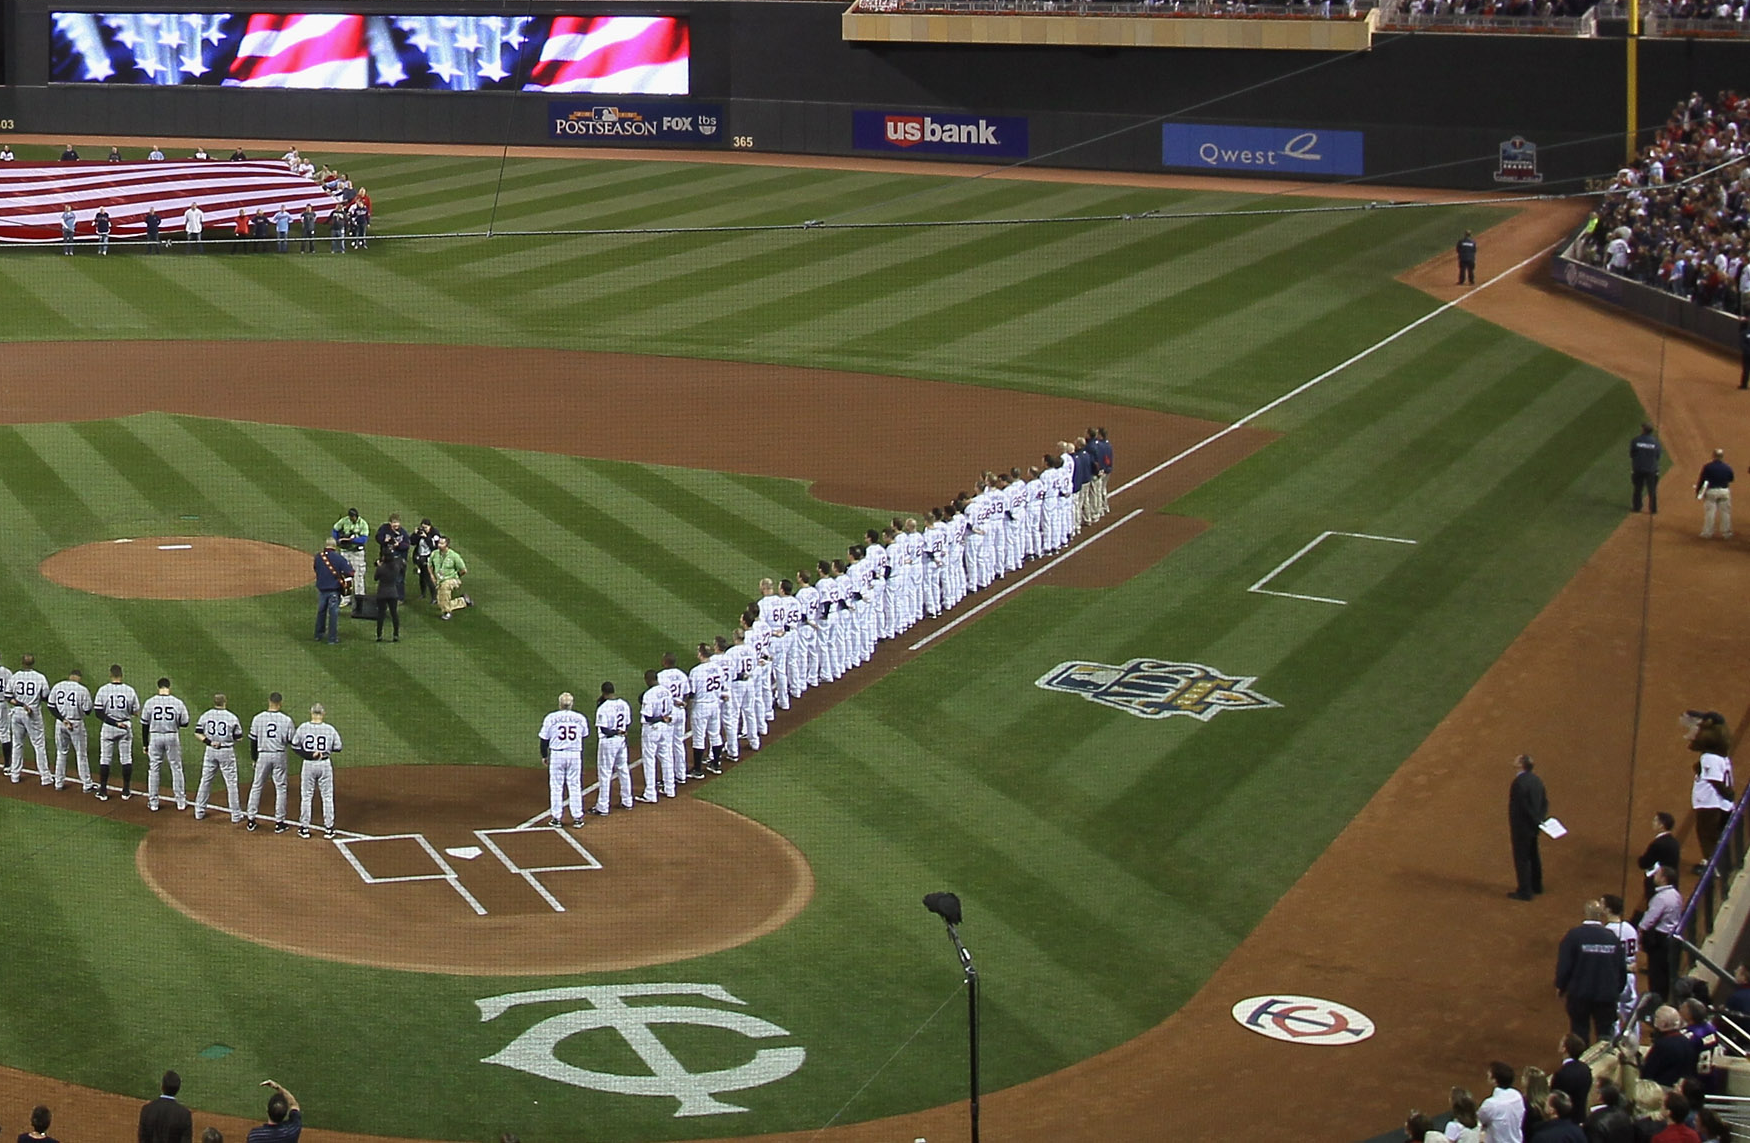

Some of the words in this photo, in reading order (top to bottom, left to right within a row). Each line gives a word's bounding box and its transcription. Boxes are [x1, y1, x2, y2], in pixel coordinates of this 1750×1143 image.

[556, 119, 657, 136] POSTSEASON
[663, 116, 693, 131] FOX
[698, 115, 717, 126] tbs
[733, 136, 754, 148] 365
[1200, 143, 1277, 165] Qwest
[773, 608, 785, 622] 60
[741, 658, 752, 672] 16
[16, 681, 35, 696] 38
[670, 684, 681, 698] 21
[706, 676, 721, 692] 25
[56, 690, 76, 706] 24
[109, 695, 126, 709] 13
[153, 706, 174, 721] 25
[616, 713, 625, 728] 2
[207, 720, 227, 736] 33
[266, 723, 277, 738] 2
[557, 725, 577, 741] 35
[304, 735, 326, 751] 28
